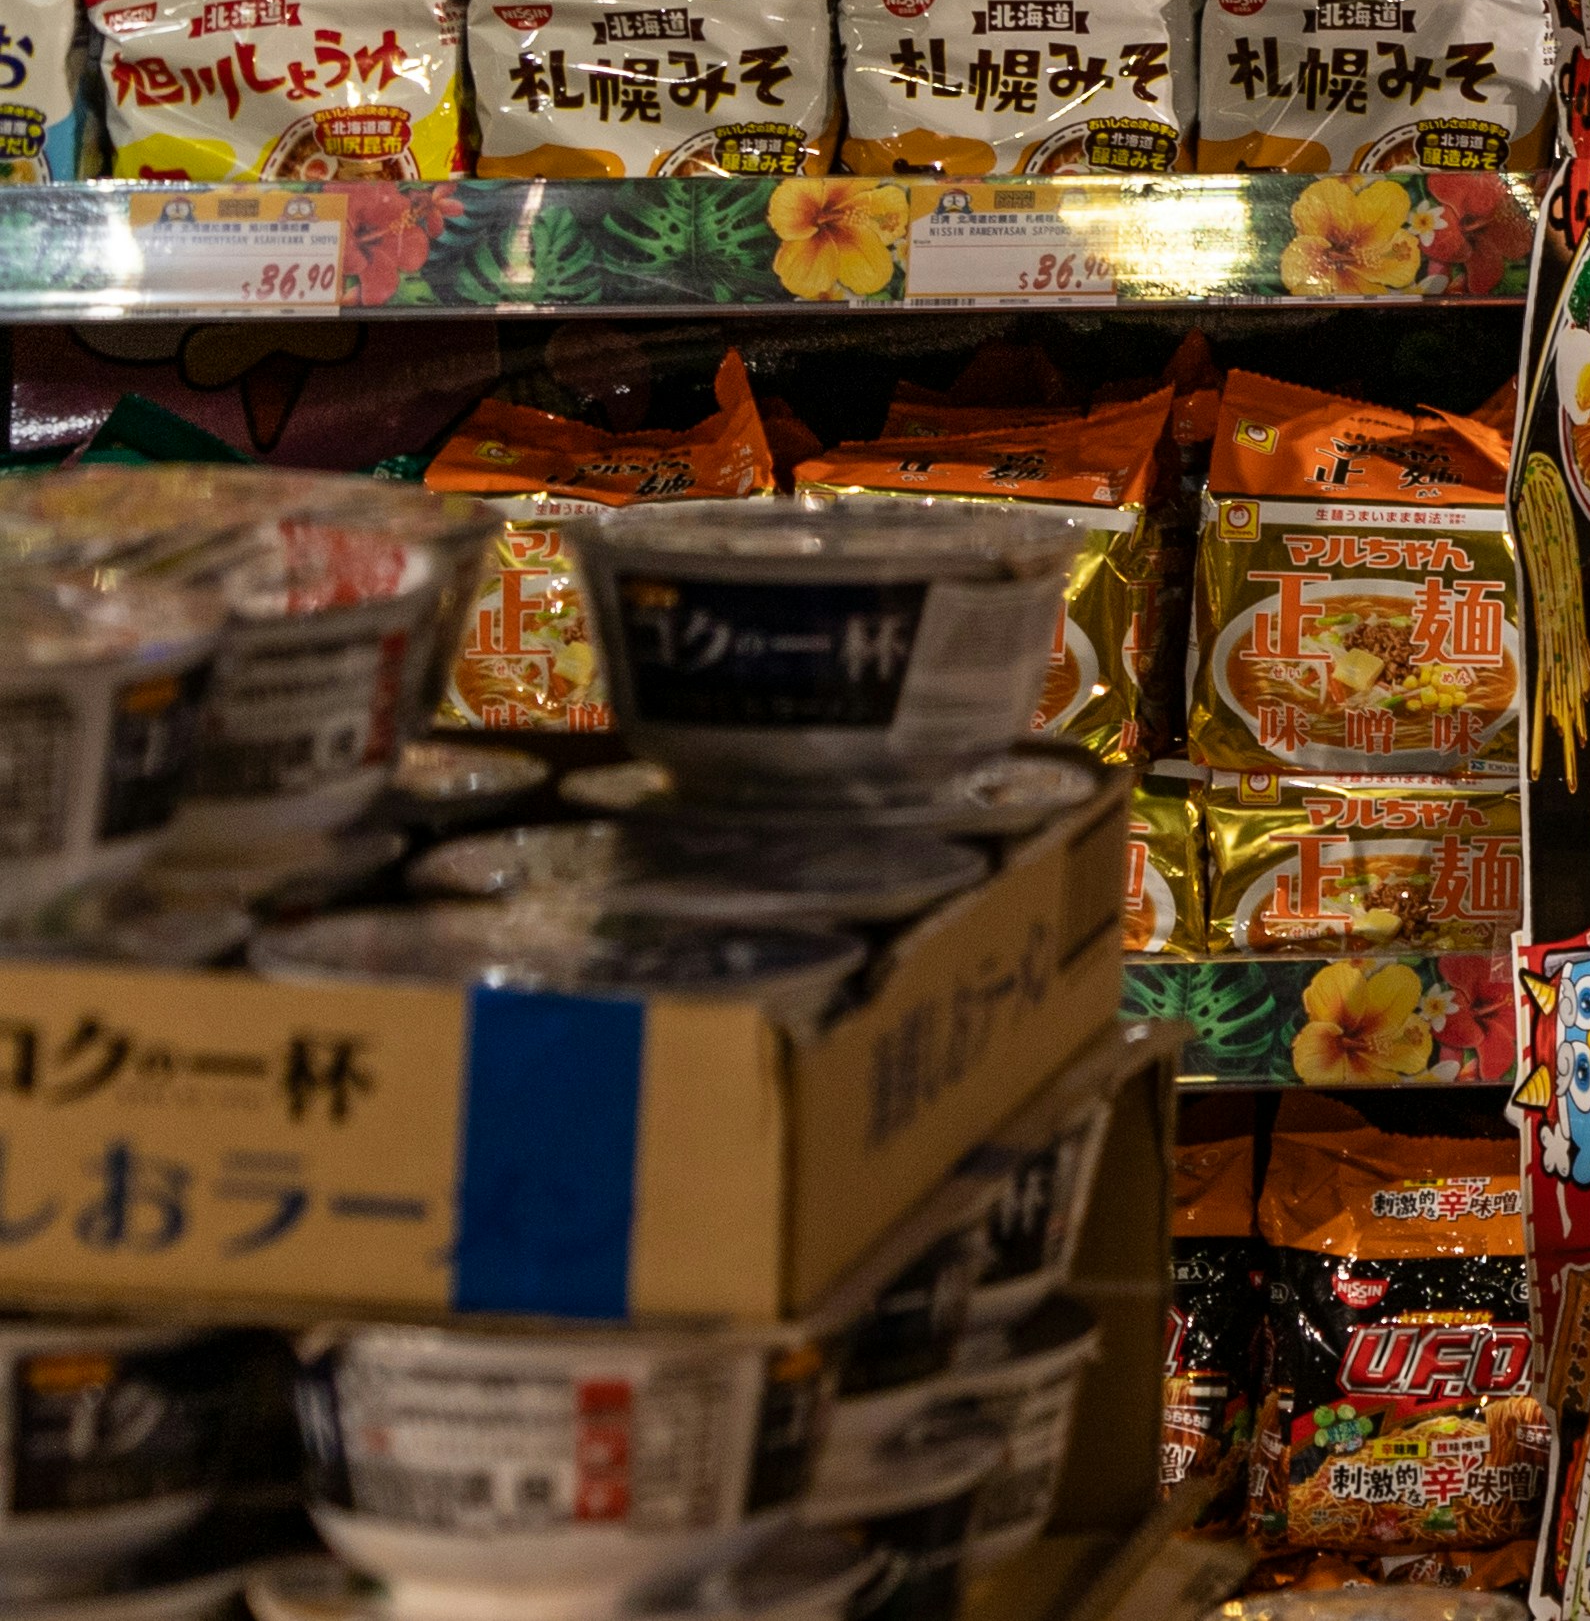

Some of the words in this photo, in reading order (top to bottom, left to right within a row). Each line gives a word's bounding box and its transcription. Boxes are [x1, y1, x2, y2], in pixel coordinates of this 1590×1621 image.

[988, 3, 1075, 32] 北海道
[114, 31, 408, 120] 旭川しょうゆ
[509, 46, 794, 123] 札幌みそ
[889, 39, 1170, 114] 札幌みそ
[1228, 37, 1495, 114] 札幌みそ
[242, 263, 335, 300] $36.90
[1283, 535, 1473, 572] マルちゃん
[1303, 798, 1491, 830] マルちゃん
